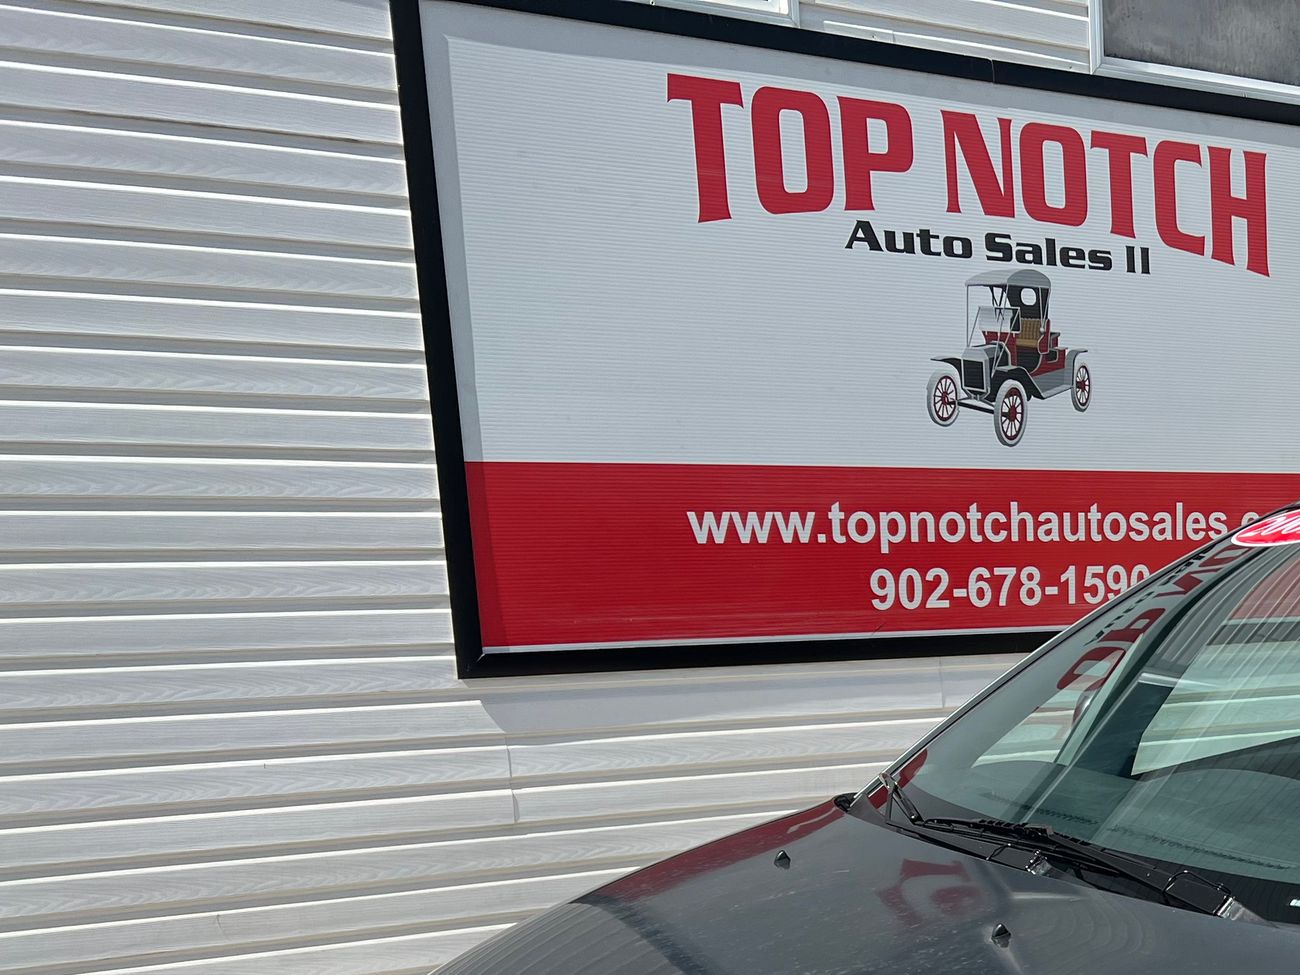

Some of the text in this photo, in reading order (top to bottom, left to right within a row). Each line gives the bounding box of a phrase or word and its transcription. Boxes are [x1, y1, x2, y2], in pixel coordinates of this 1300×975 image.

[667, 72, 1270, 277] TOP NOTCH
[844, 219, 973, 259] Auto
[984, 232, 1113, 271] Sales
[686, 501, 1260, 554] www.topnotchautosales
